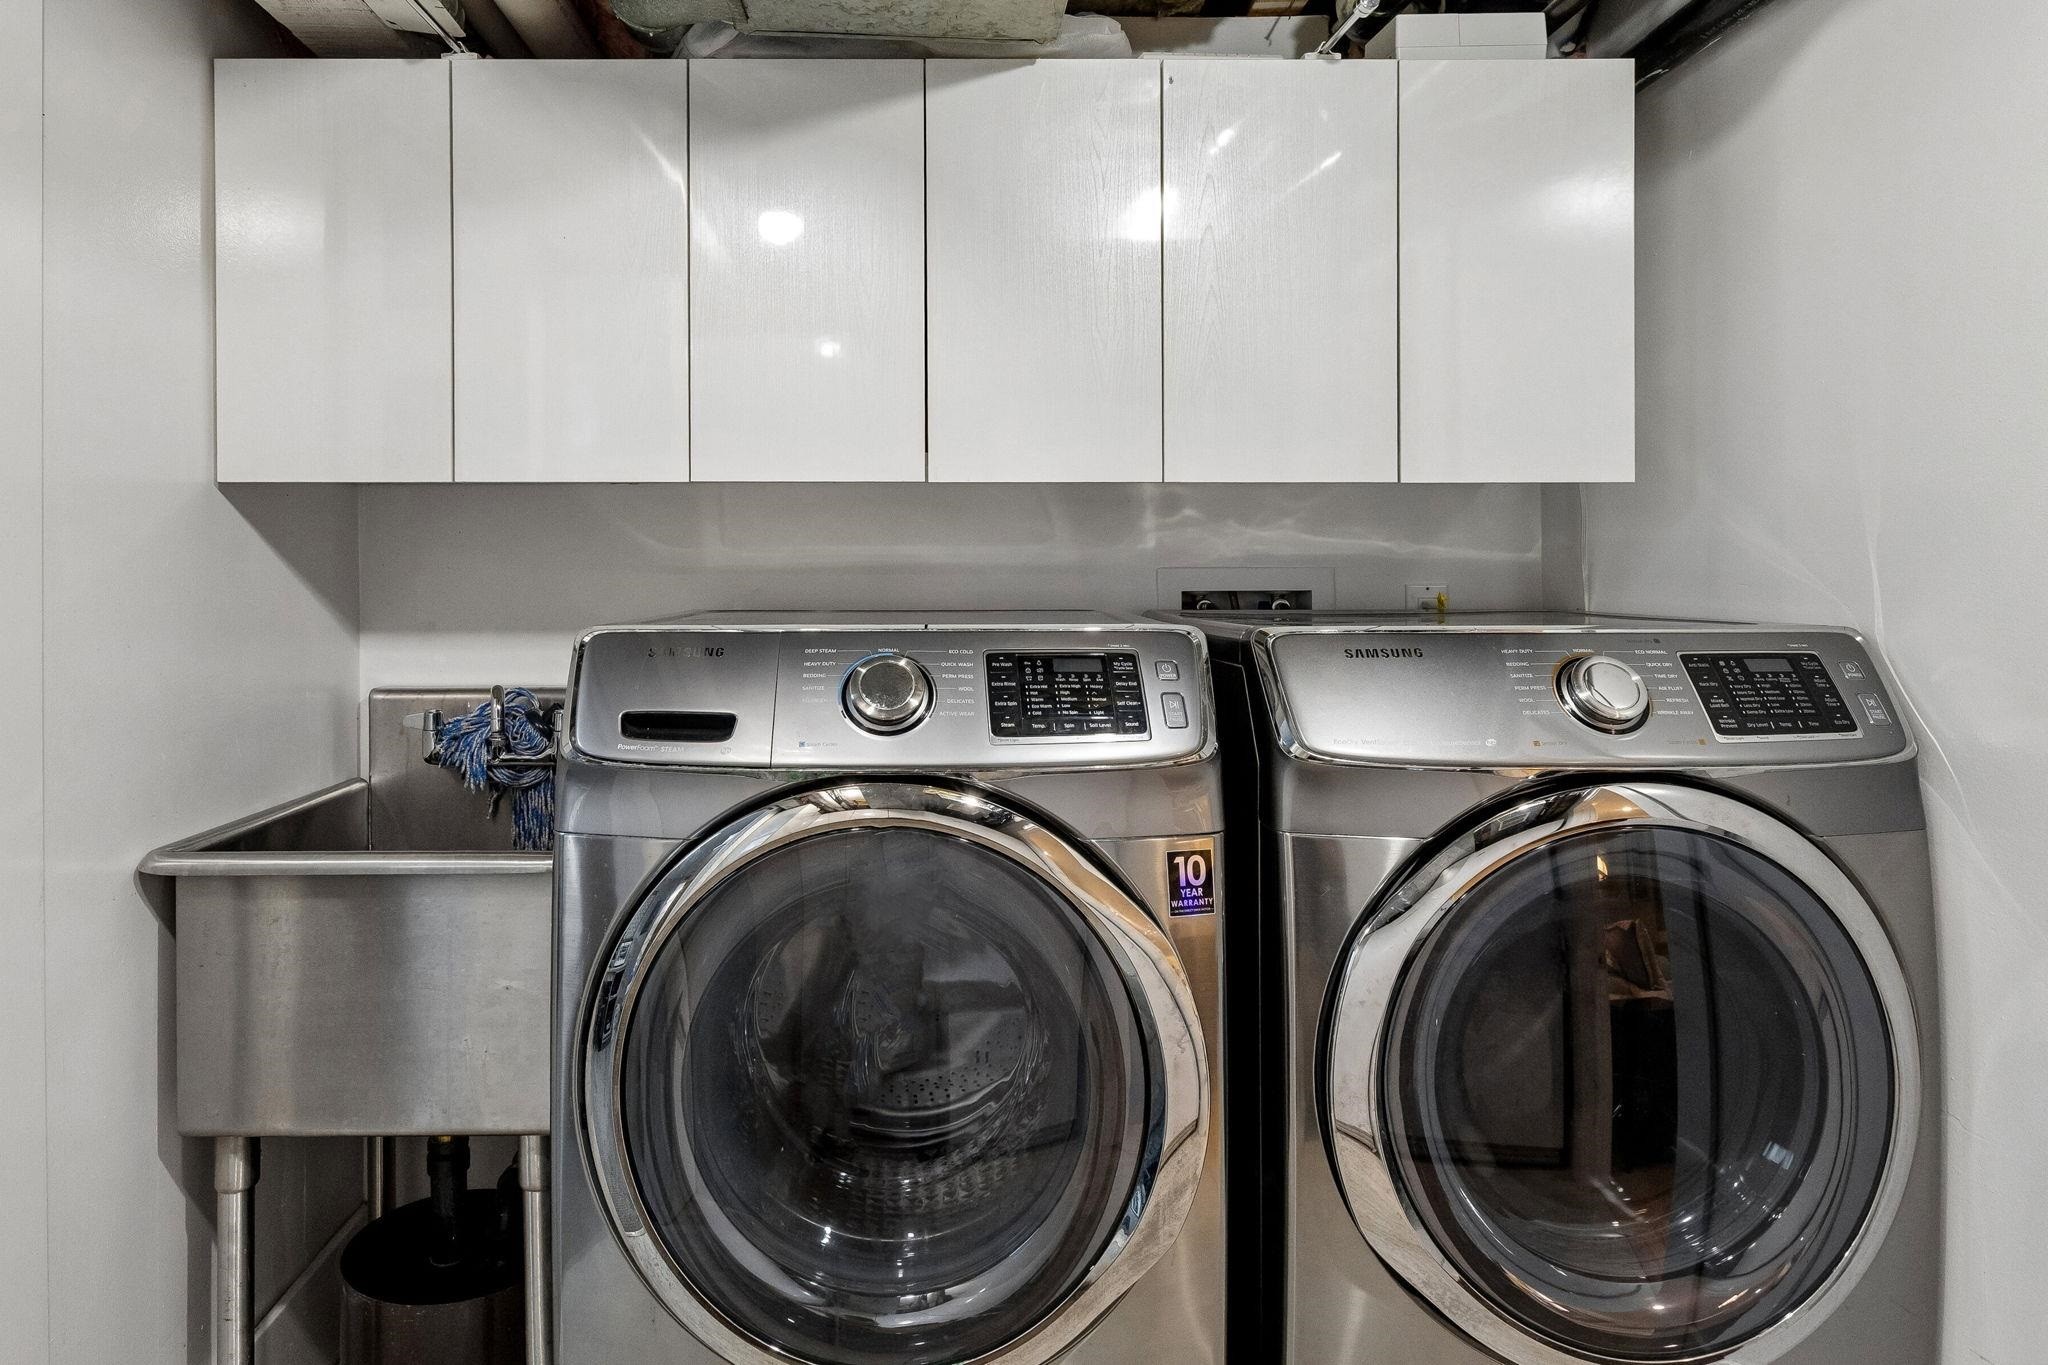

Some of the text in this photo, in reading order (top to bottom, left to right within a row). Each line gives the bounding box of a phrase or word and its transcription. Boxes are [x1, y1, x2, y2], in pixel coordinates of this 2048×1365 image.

[648, 647, 725, 658] SMSUNG
[1344, 648, 1423, 658] SAMSUNG
[1174, 854, 1206, 886] 10
[1180, 888, 1204, 898] YEAR
[1171, 898, 1213, 908] WARRANTY
